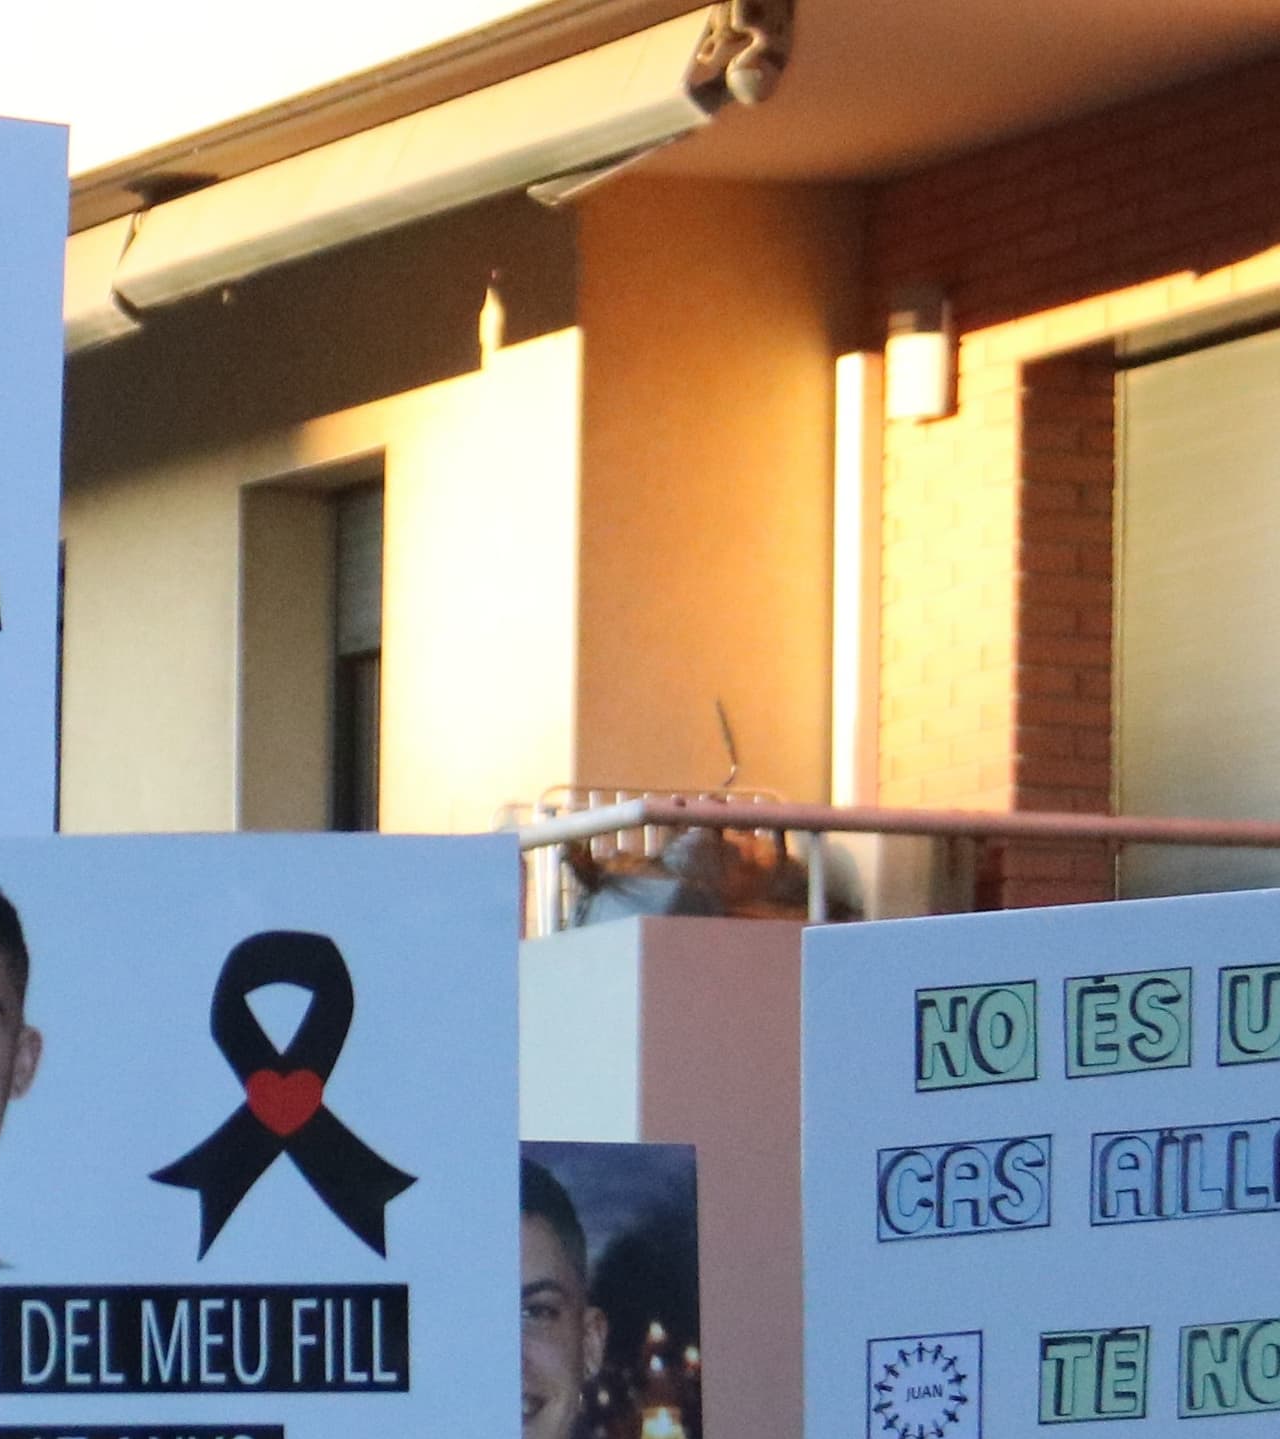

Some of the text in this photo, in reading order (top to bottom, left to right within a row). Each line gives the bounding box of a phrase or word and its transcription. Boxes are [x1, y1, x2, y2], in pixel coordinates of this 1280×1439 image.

[918, 988, 1030, 1081] NO
[1076, 976, 1183, 1068] ÉS
[880, 1127, 1280, 1235] CAS AÏLL
[20, 1298, 126, 1387] DEL
[140, 1296, 269, 1385] MEU
[292, 1296, 398, 1384] FILL
[1040, 1326, 1142, 1418] TÉ
[906, 1383, 943, 1402] JUAN
